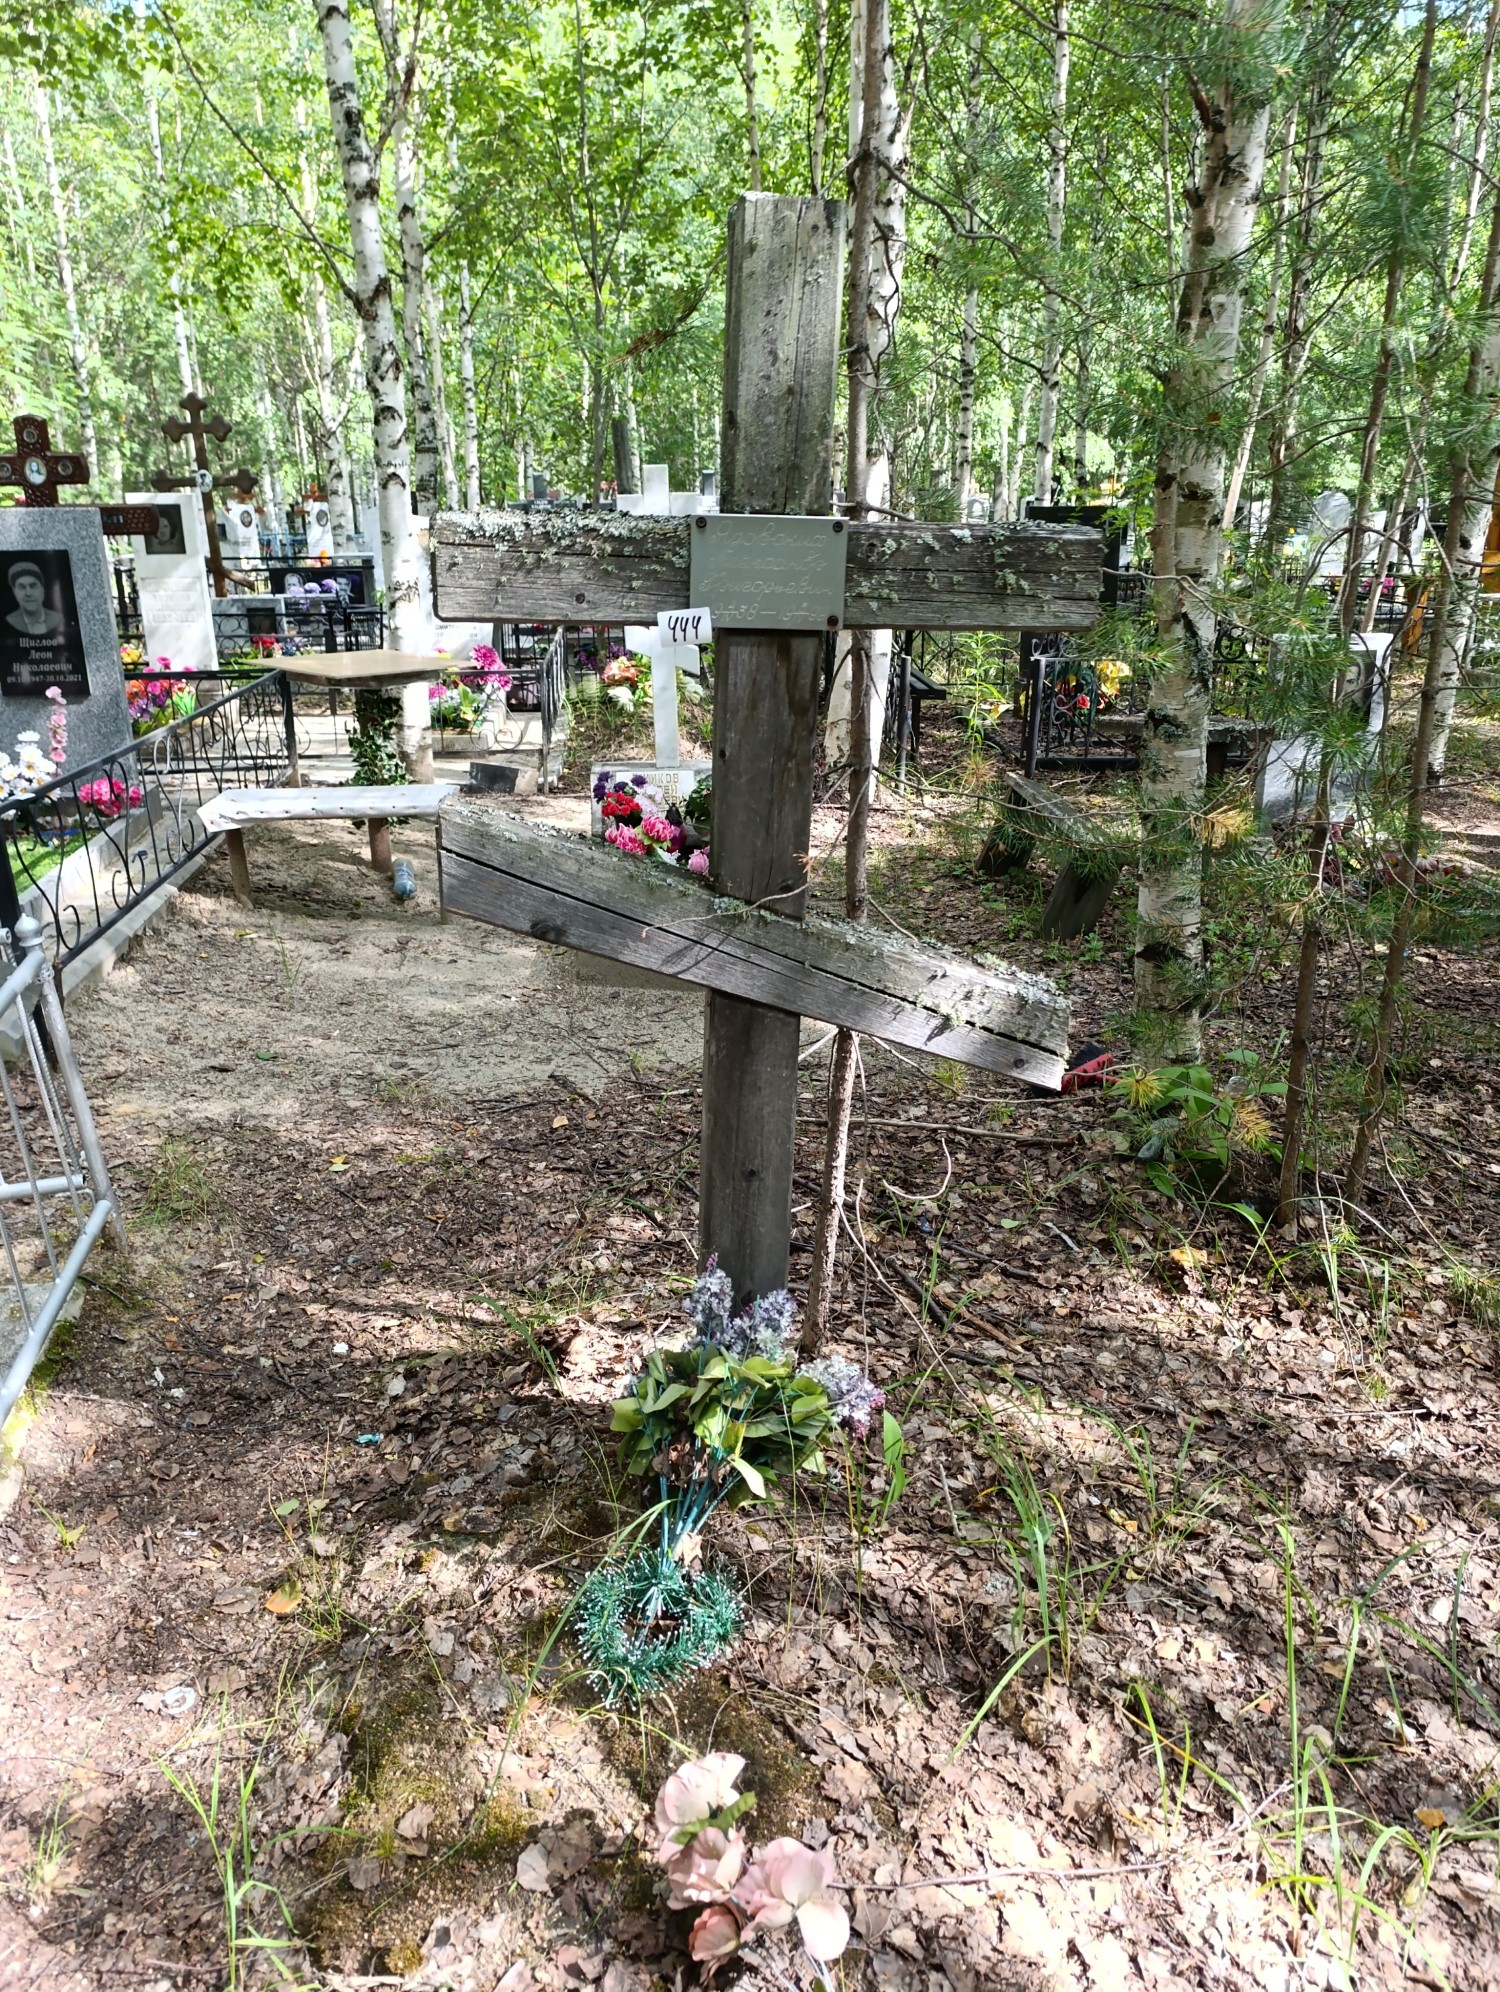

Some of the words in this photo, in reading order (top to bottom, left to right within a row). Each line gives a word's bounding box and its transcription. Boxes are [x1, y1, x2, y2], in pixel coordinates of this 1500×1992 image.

[668, 615, 702, 643] 444
[19, 637, 58, 648] Щиглов
[28, 650, 53, 659] Леон
